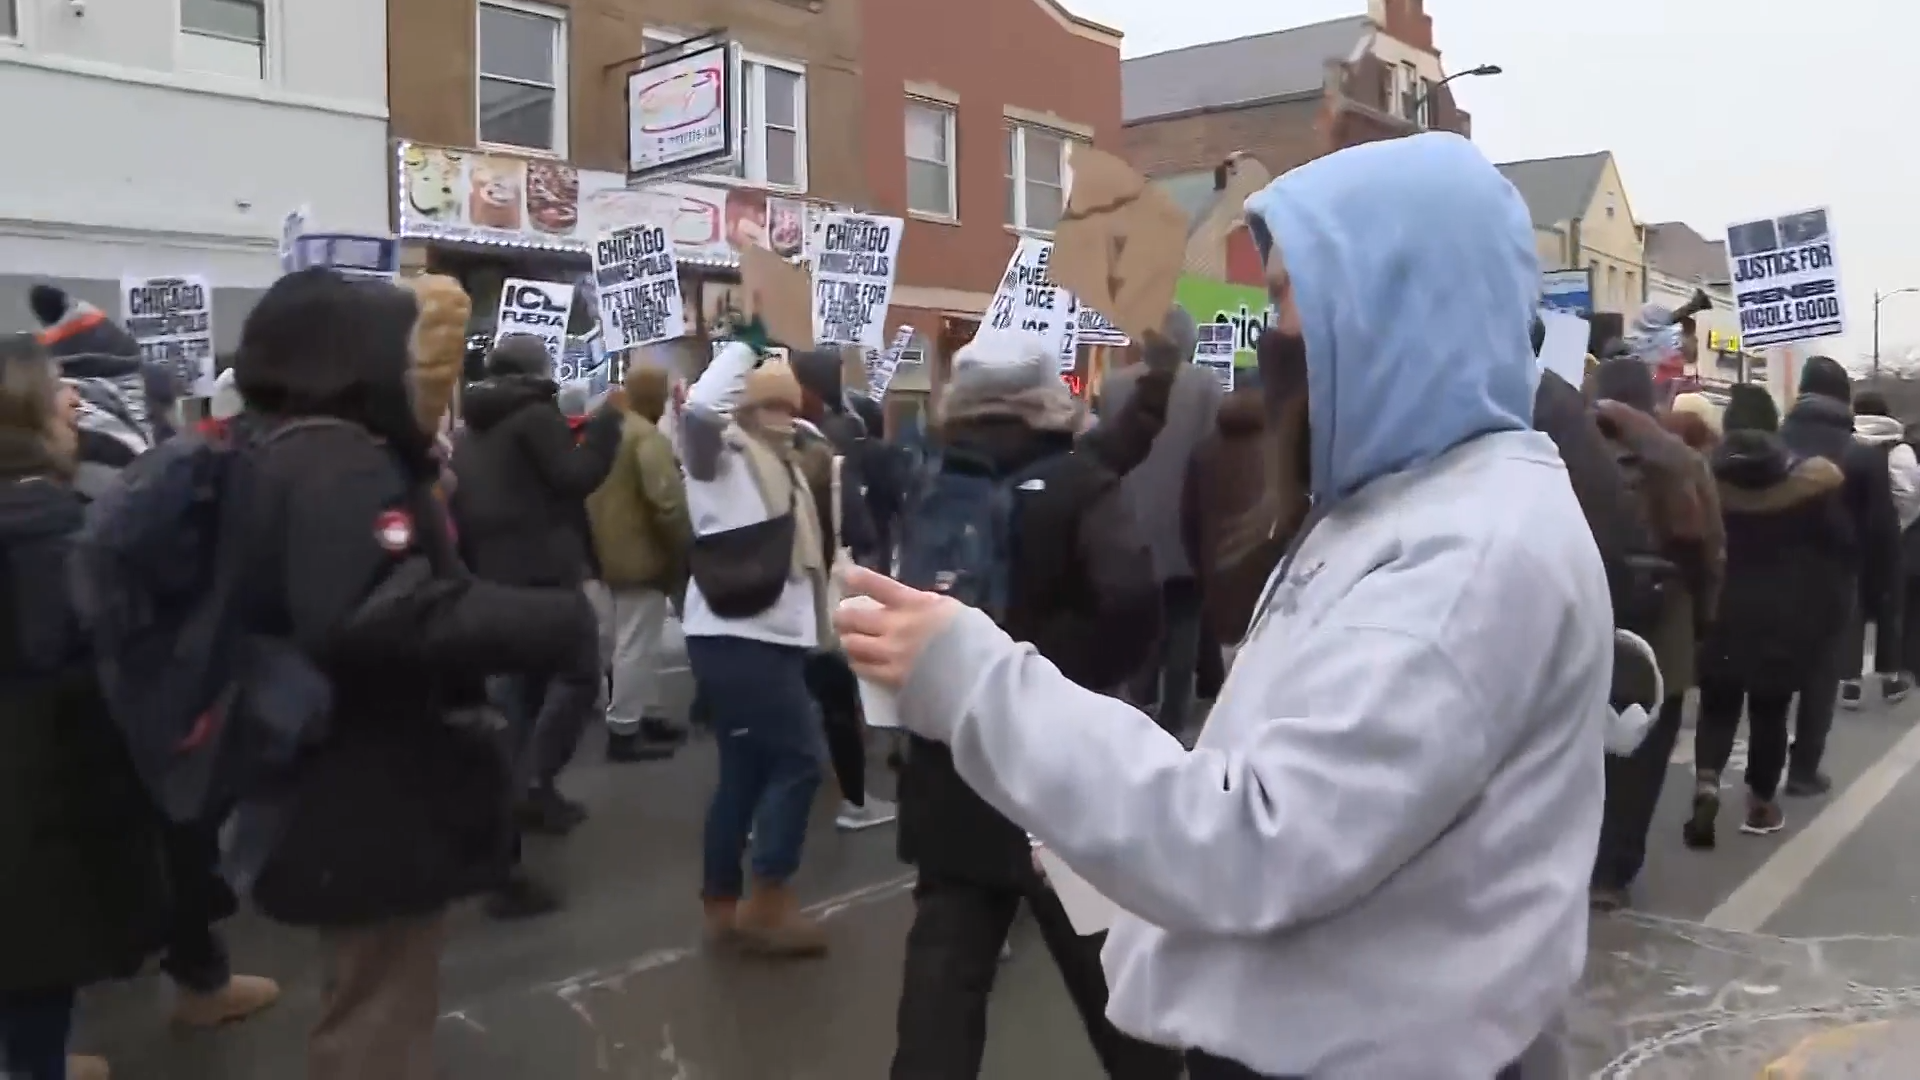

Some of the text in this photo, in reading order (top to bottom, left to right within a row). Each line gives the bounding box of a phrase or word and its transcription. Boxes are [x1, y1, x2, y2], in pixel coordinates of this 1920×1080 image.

[597, 228, 664, 265] CHICAGO
[826, 223, 889, 253] CHICAGO
[597, 254, 672, 287] EAPOLIS
[1735, 244, 1832, 282] JUSTICE FOR
[129, 284, 204, 315] CHICAGO
[1025, 288, 1056, 309] DICE
[1737, 279, 1835, 307] RENEE
[502, 310, 564, 327] FUERA
[1740, 297, 1839, 331] NICOLE GOOD
